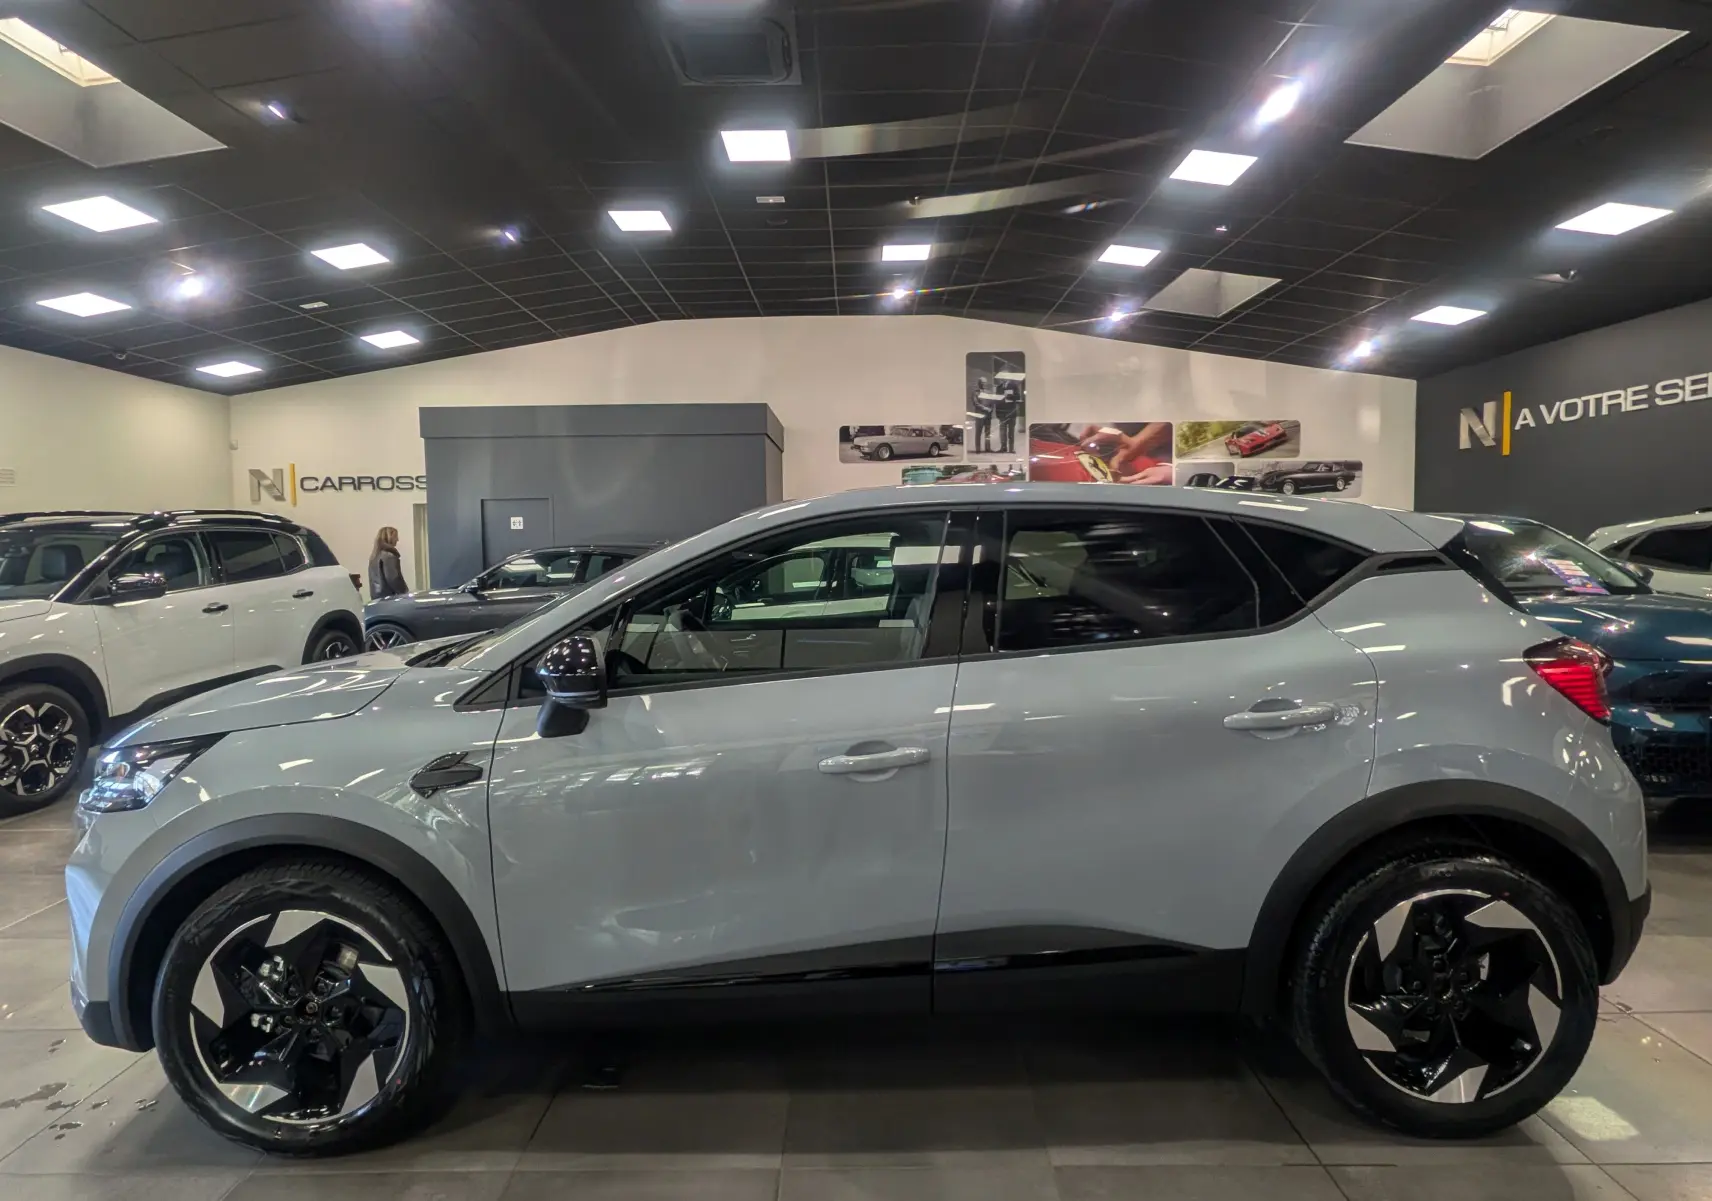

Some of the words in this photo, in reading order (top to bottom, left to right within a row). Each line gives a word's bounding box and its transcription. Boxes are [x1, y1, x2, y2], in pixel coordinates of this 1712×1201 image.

[1459, 401, 1497, 450] N
[1514, 408, 1536, 431] A
[1539, 384, 1649, 425] VOTRE
[1654, 371, 1712, 406] SE
[248, 468, 286, 502] N
